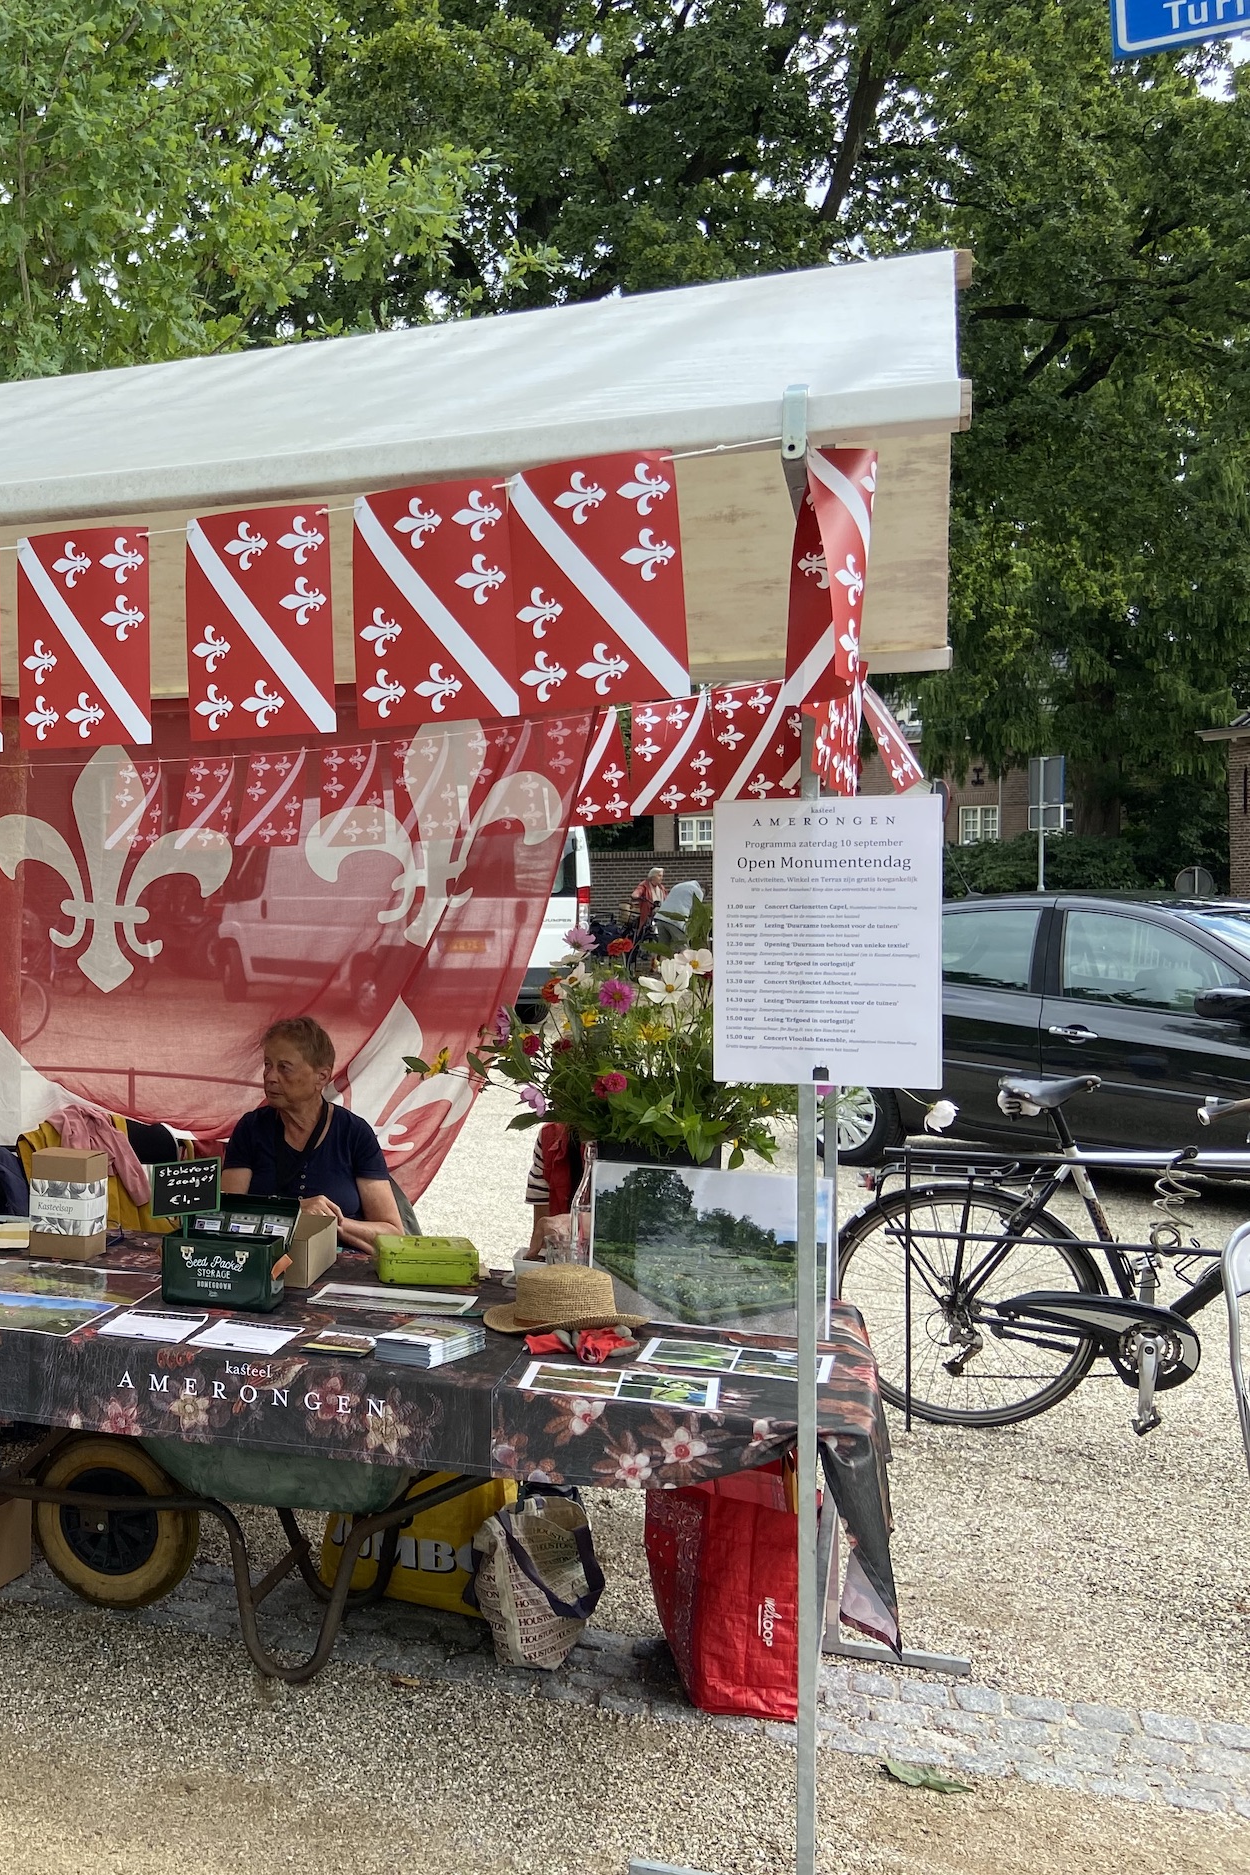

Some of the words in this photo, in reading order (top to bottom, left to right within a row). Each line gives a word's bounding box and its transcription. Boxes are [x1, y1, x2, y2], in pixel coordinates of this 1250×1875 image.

[752, 816, 896, 827] AMERONGEN
[744, 840, 797, 849] Programma
[799, 840, 838, 848] zaterdag
[840, 839, 852, 847] 10
[854, 838, 903, 848] september
[737, 856, 775, 872] Open
[781, 855, 912, 870] Monumentendag
[877, 876, 918, 884] toegankelijk
[37, 1201, 74, 1214] Kasteelsap
[186, 1256, 208, 1268] Seed
[210, 1256, 244, 1272] Packet
[196, 1268, 230, 1280] STORAGE
[196, 1280, 232, 1290] HOMEGROWN
[225, 1360, 272, 1378] kasteel
[117, 1371, 386, 1418] AMERONGEN
[520, 1628, 554, 1644] HOUSTON
[523, 1645, 557, 1661] HOUSTON
